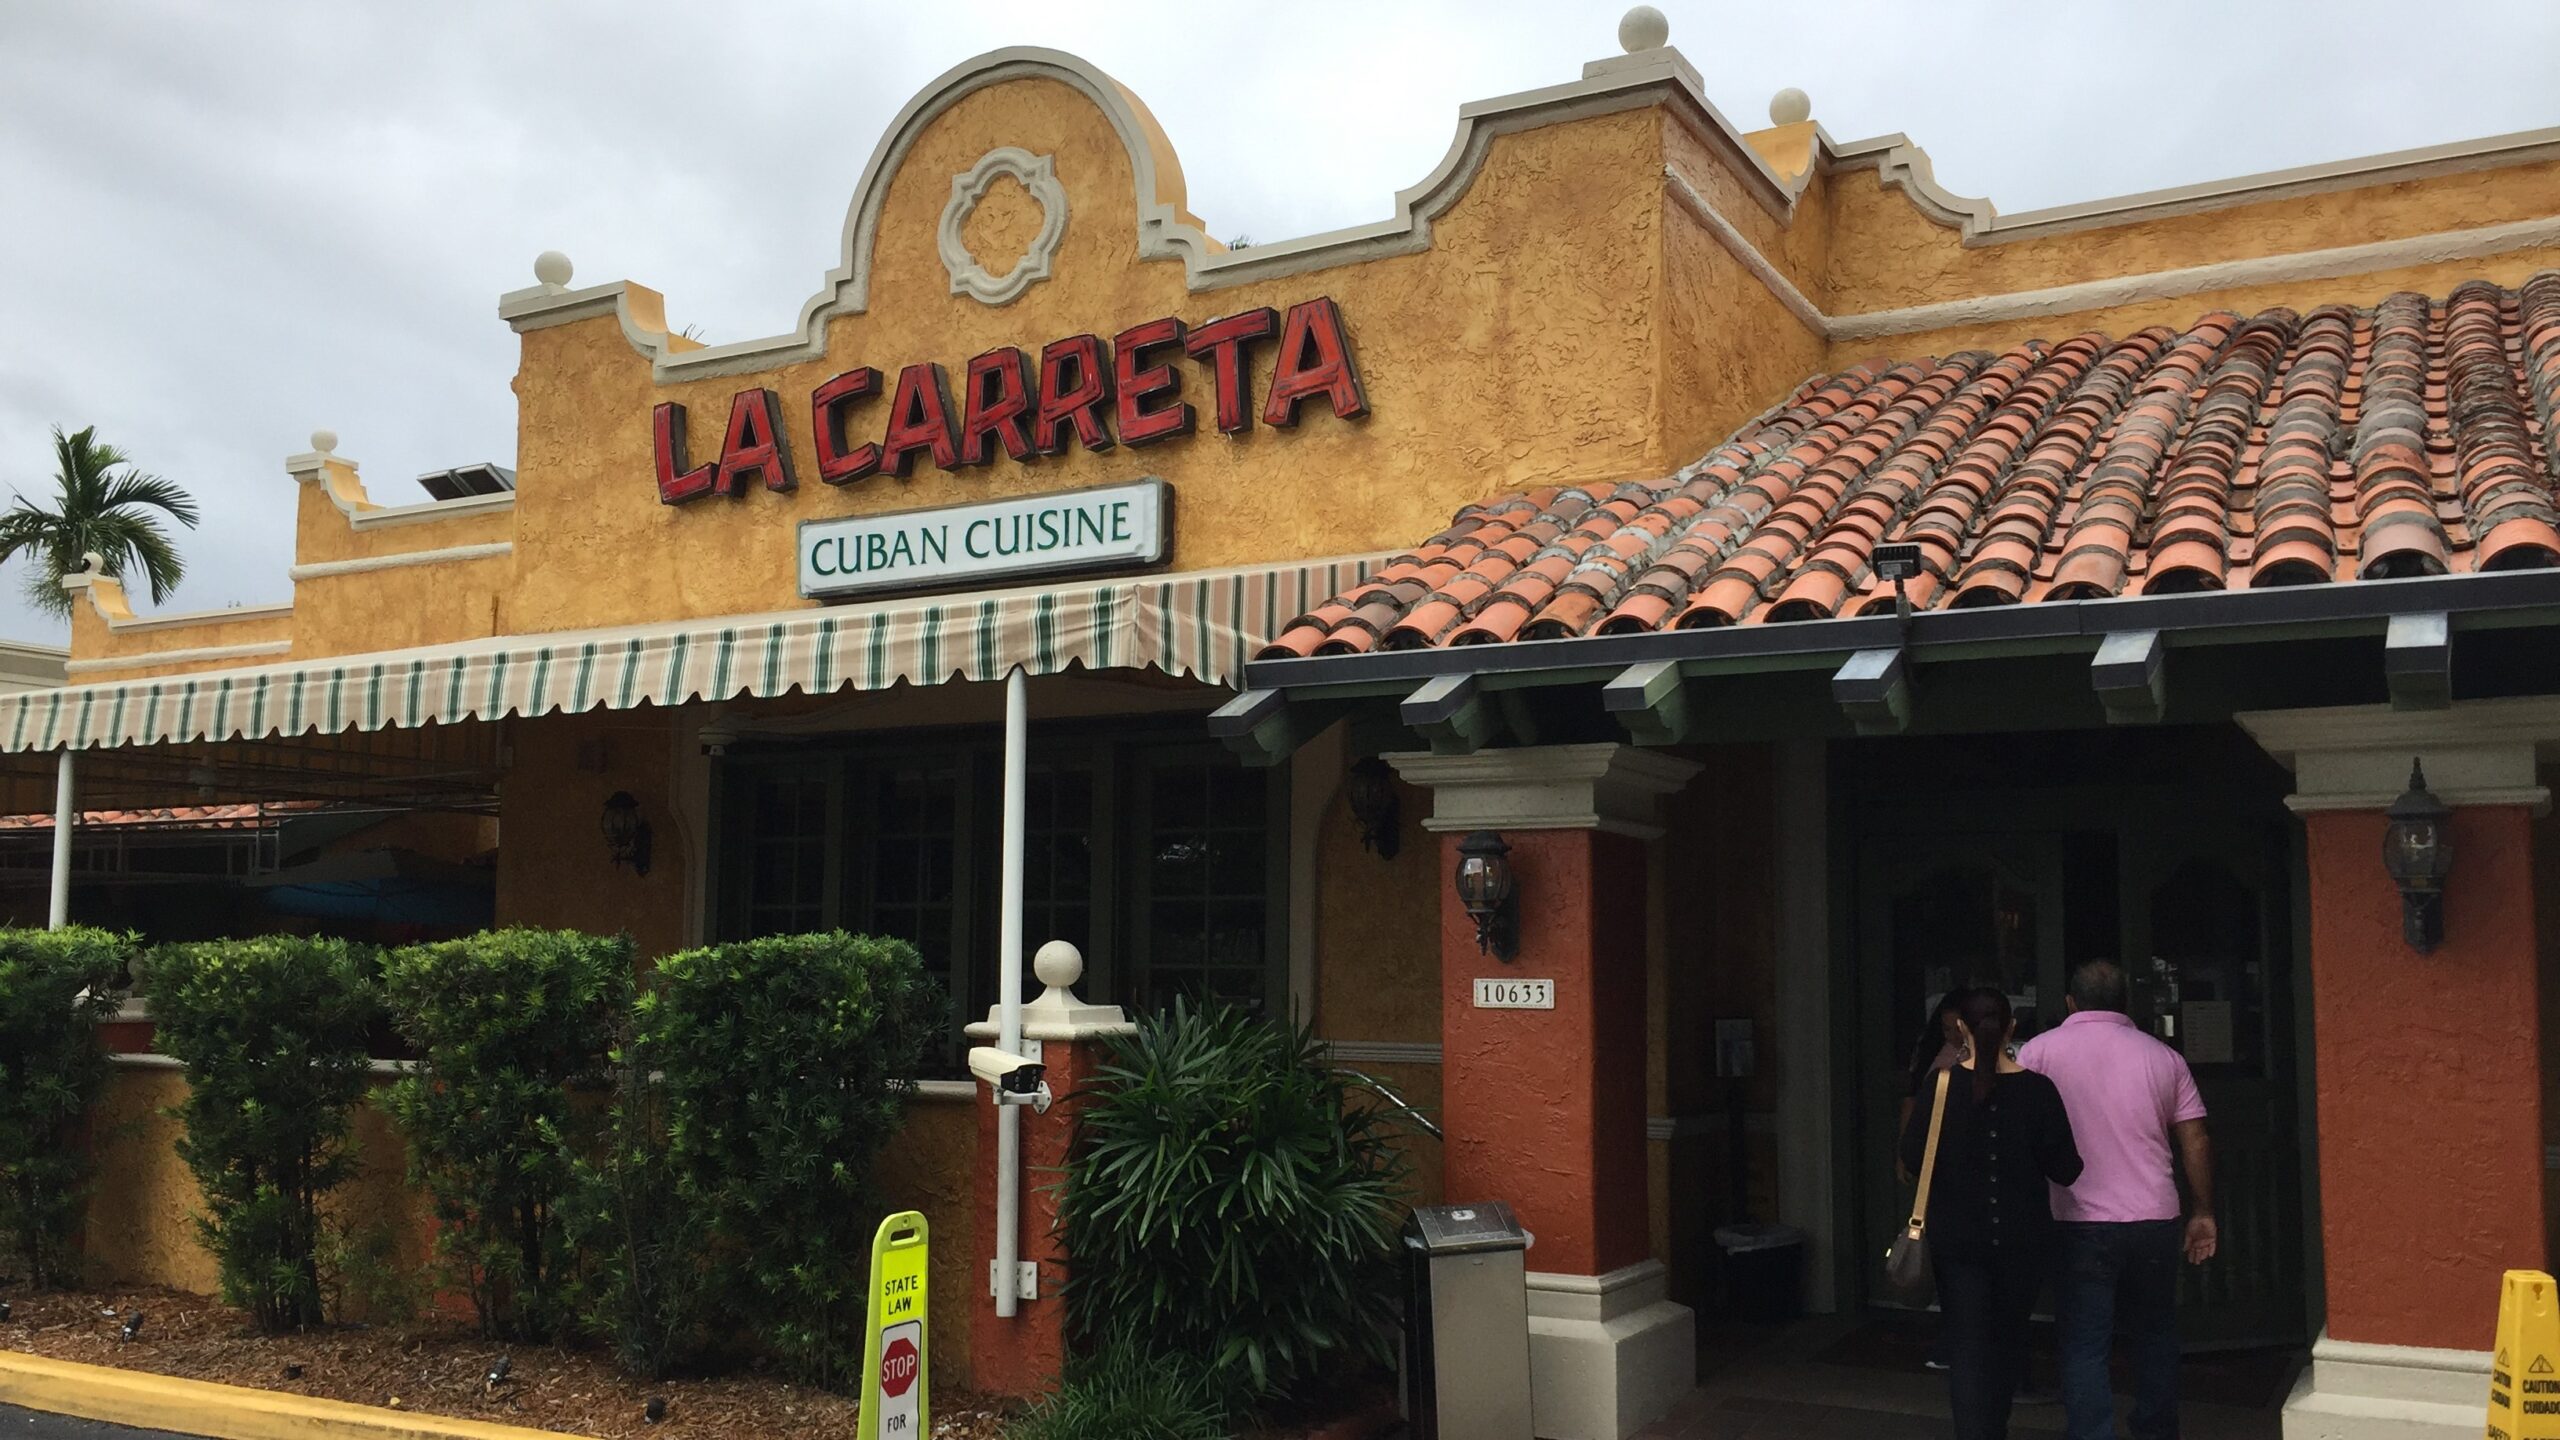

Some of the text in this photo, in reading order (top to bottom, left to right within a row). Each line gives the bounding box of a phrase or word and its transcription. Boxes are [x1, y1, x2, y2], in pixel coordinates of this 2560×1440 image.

[652, 296, 1372, 506] LA CARRETA
[810, 501, 1133, 577] CUBAN CUISINE
[1483, 984, 1545, 1004] 10633
[884, 1275, 919, 1297] STATE
[887, 1296, 912, 1316] LAW
[882, 1353, 916, 1383] STOP
[887, 1413, 907, 1434] FOR
